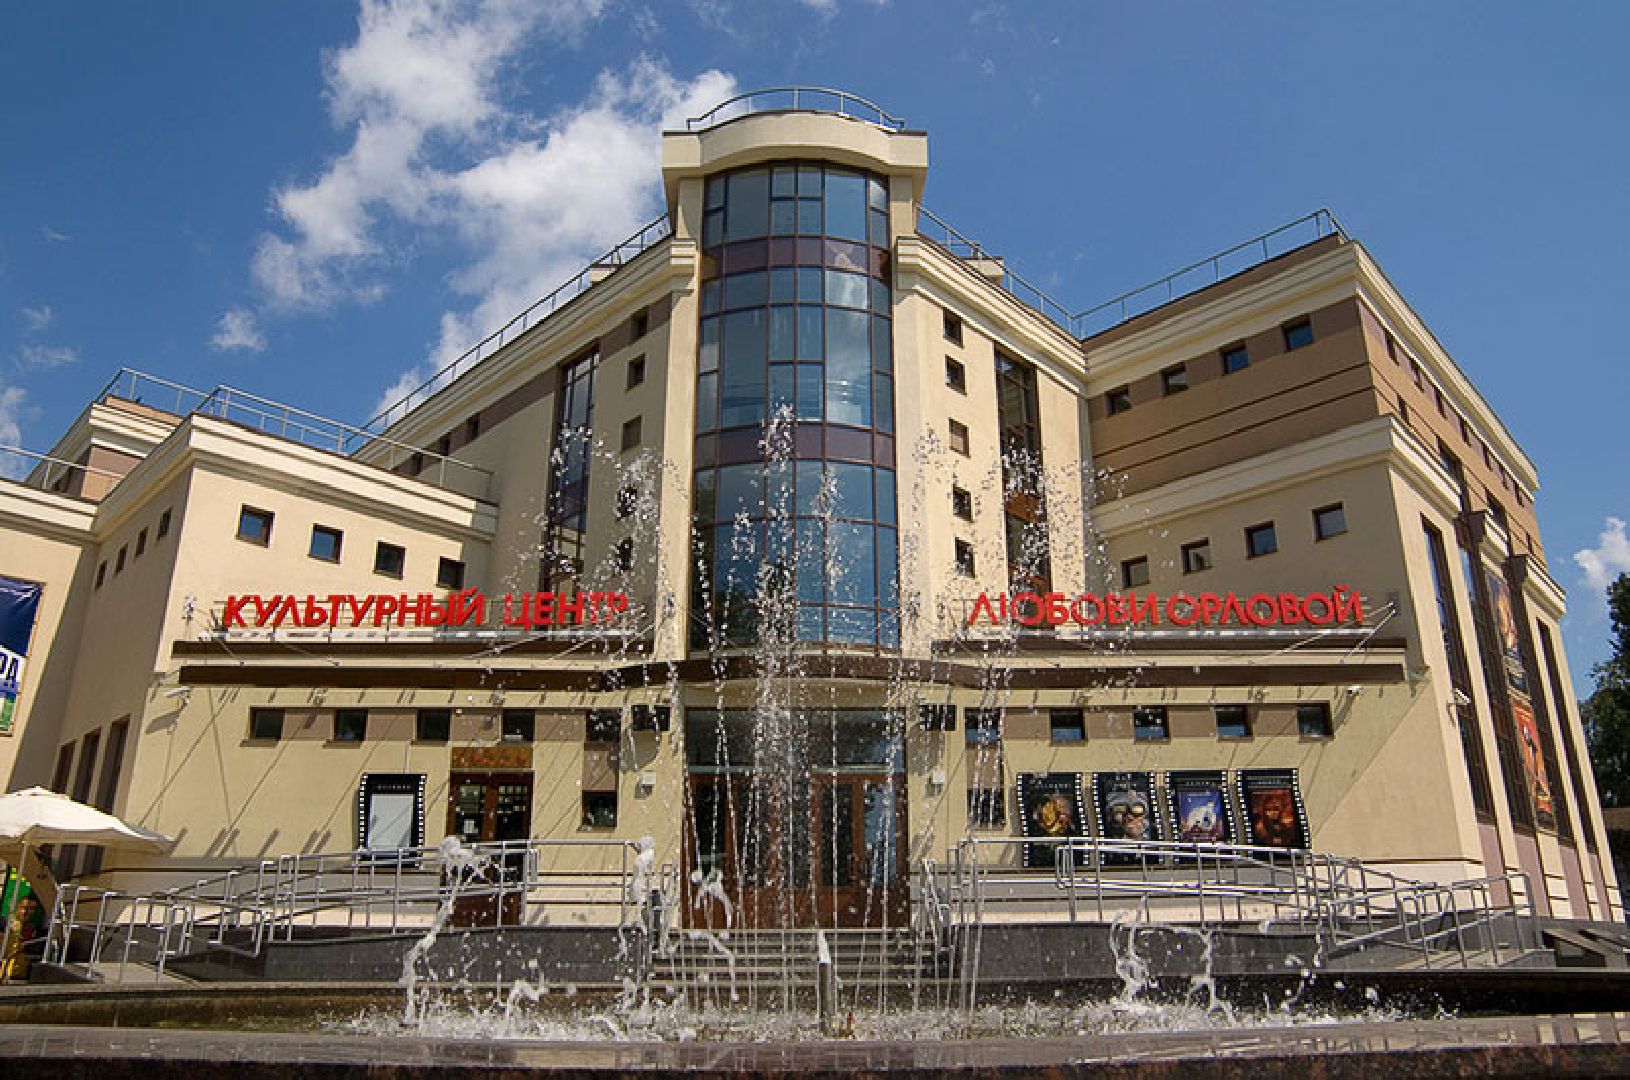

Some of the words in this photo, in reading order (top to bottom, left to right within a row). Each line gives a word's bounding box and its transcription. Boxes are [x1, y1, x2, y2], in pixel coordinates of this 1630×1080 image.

[223, 586, 485, 627] КУЛЬТУРНЫЙ
[503, 591, 628, 630] ЦЕНТР
[967, 591, 1160, 626] ЛЮБОВИ
[1166, 585, 1364, 626] ОРЛОВОЙ
